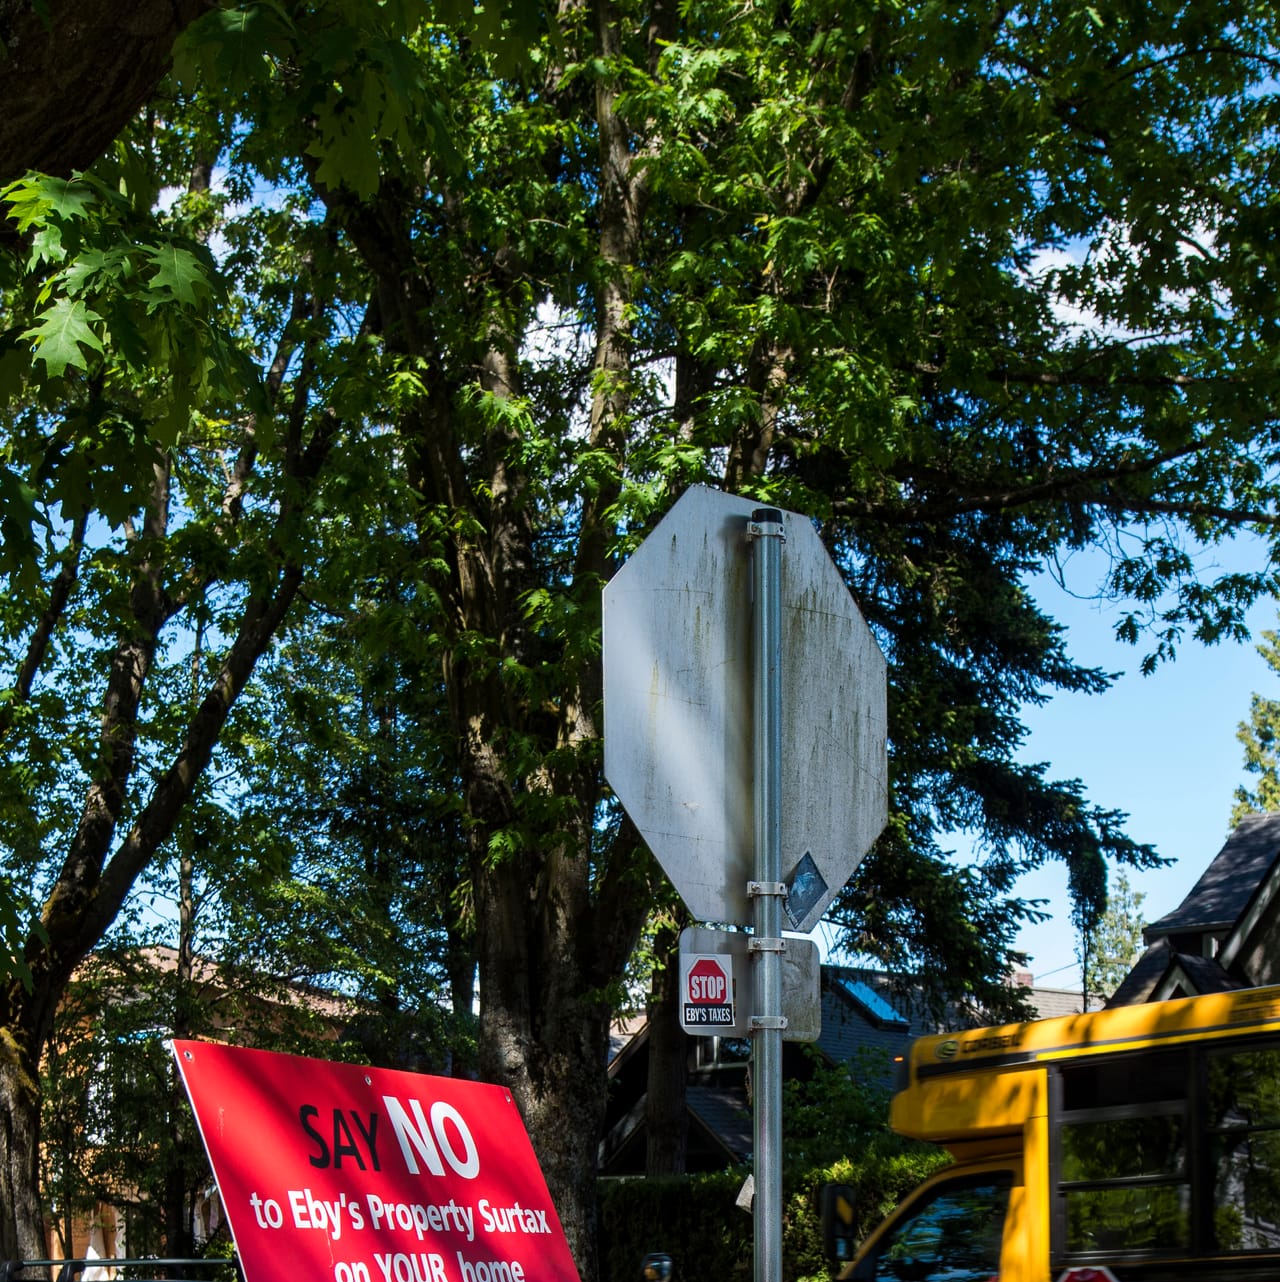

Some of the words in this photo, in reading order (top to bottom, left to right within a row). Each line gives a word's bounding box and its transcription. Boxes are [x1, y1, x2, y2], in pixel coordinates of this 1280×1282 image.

[691, 975, 725, 999] STOP
[686, 1007, 707, 1022] EBY'S
[708, 1008, 731, 1022] TAXES
[299, 1104, 381, 1172] SAY
[382, 1095, 480, 1179] NO
[250, 1191, 283, 1229] to
[287, 1188, 365, 1241] Eby's
[366, 1194, 475, 1242] Property
[478, 1199, 552, 1234] Surtax
